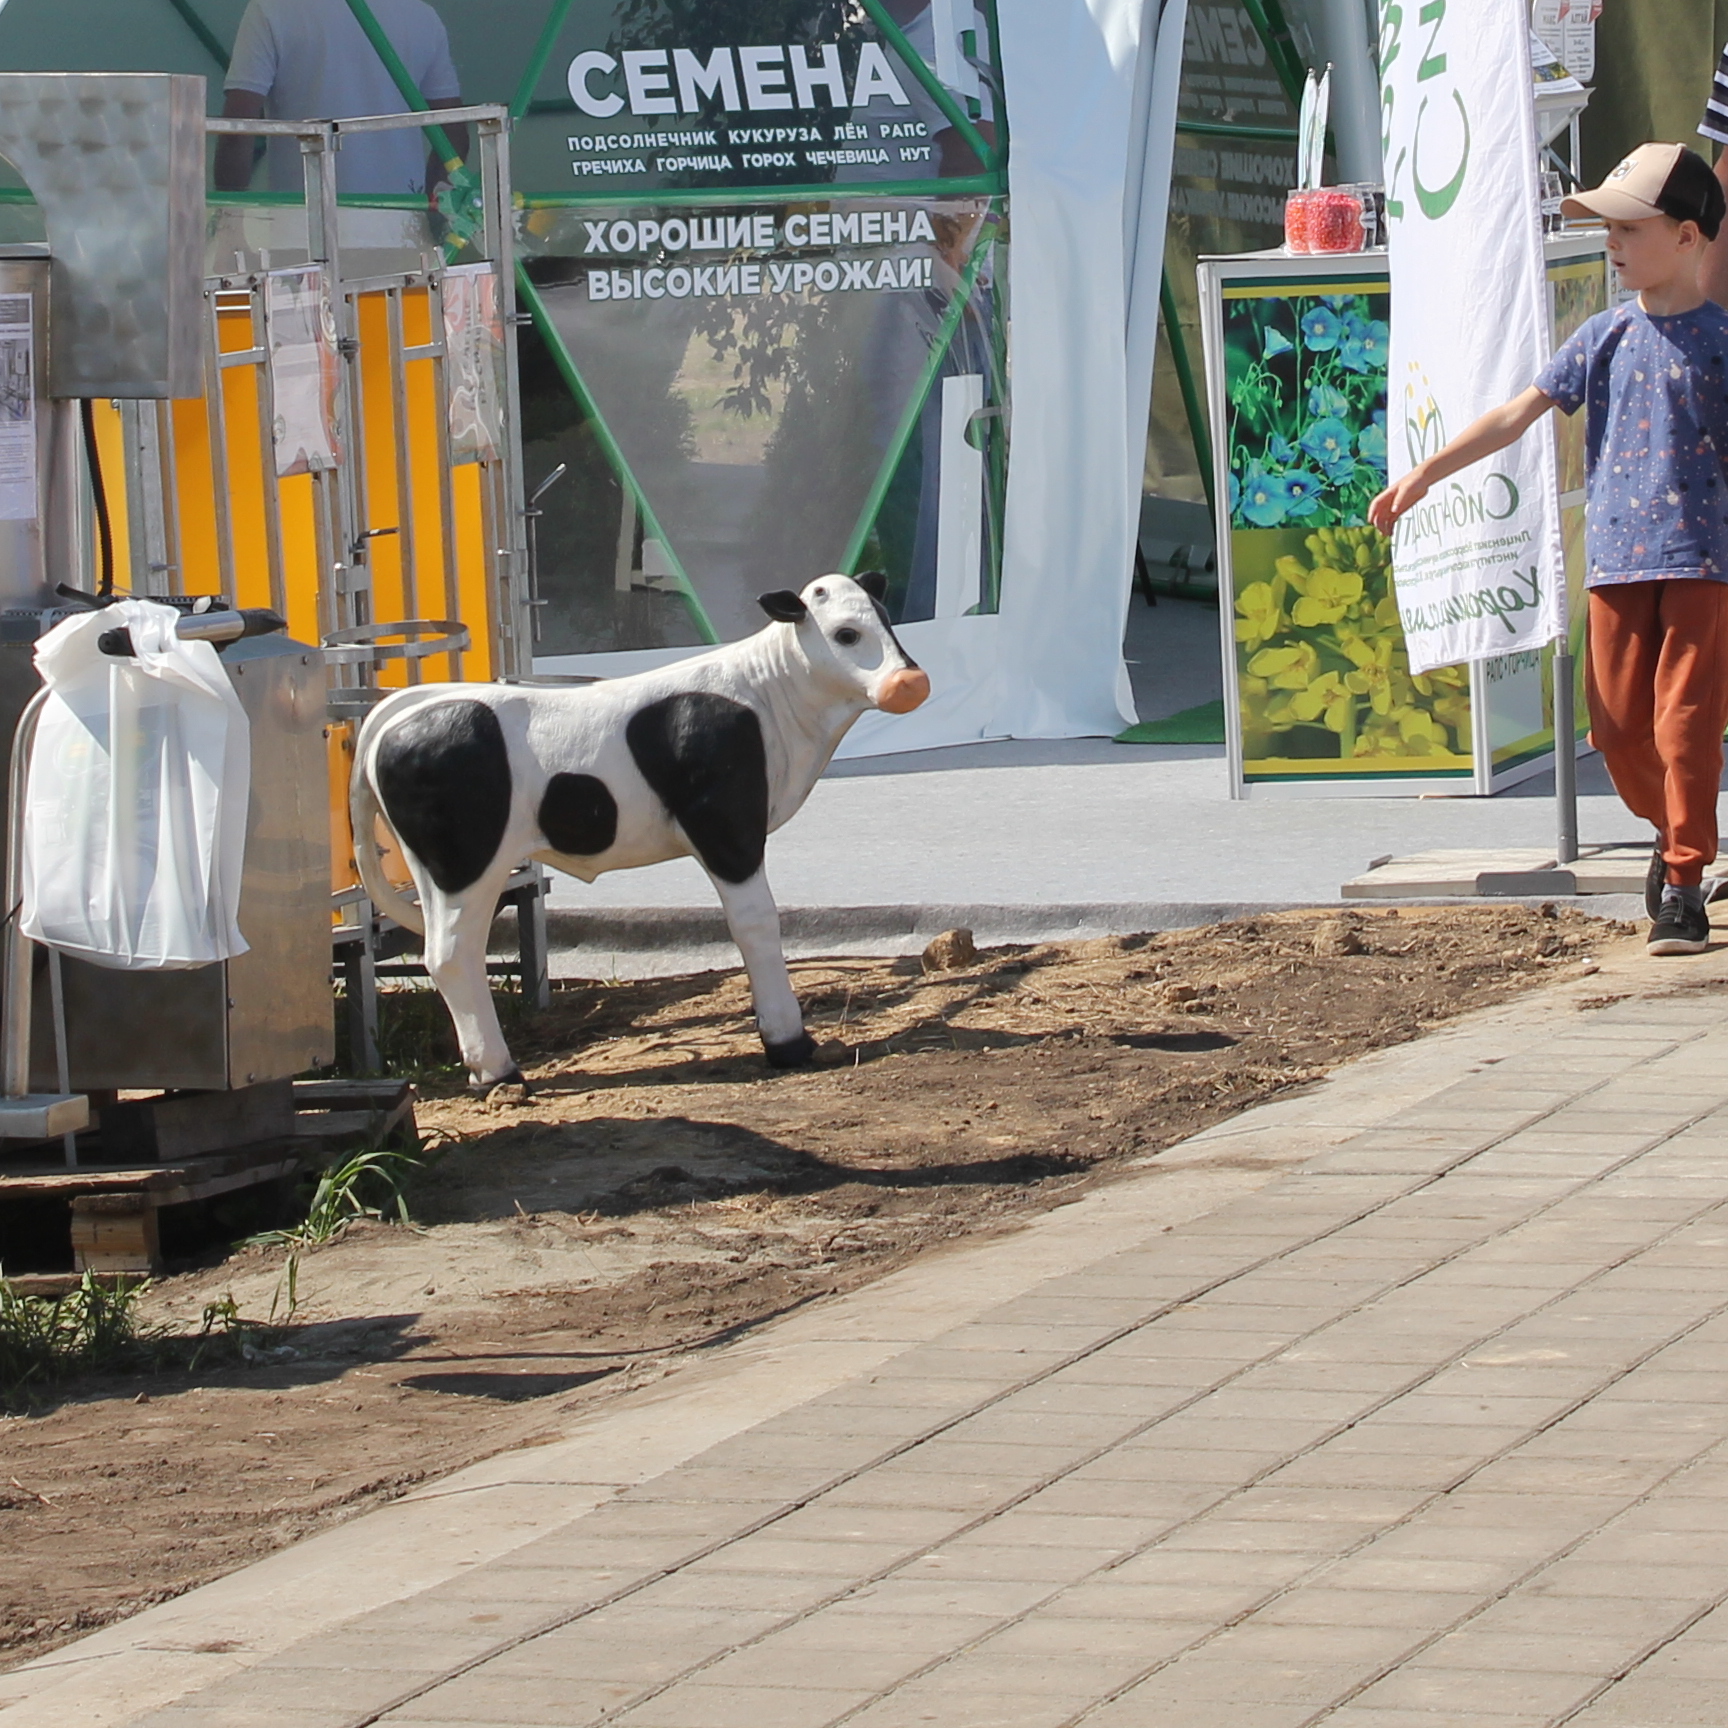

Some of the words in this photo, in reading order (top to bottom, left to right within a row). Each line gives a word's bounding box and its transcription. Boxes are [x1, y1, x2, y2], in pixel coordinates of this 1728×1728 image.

[567, 42, 910, 118] СЕМЕНА
[568, 131, 717, 152] ПОДСОЛНЕЧНИК
[728, 126, 822, 145] КУКУРУЗА
[833, 121, 869, 141] ЛЁН
[880, 121, 928, 139] РАПС
[572, 158, 646, 177] ГРЕЧИХА
[656, 155, 732, 174] ГОРЧИЦА
[742, 152, 796, 169] ГОРОХ
[806, 147, 890, 168] ЧЕЧЕВИЦА
[900, 145, 932, 163] НУТ
[583, 216, 776, 254] ХОРОШИЕ
[784, 210, 936, 246] СЕМЕНА
[587, 266, 762, 301] ВЫСОКИЕ
[771, 257, 933, 295] УРОЖАИ!
